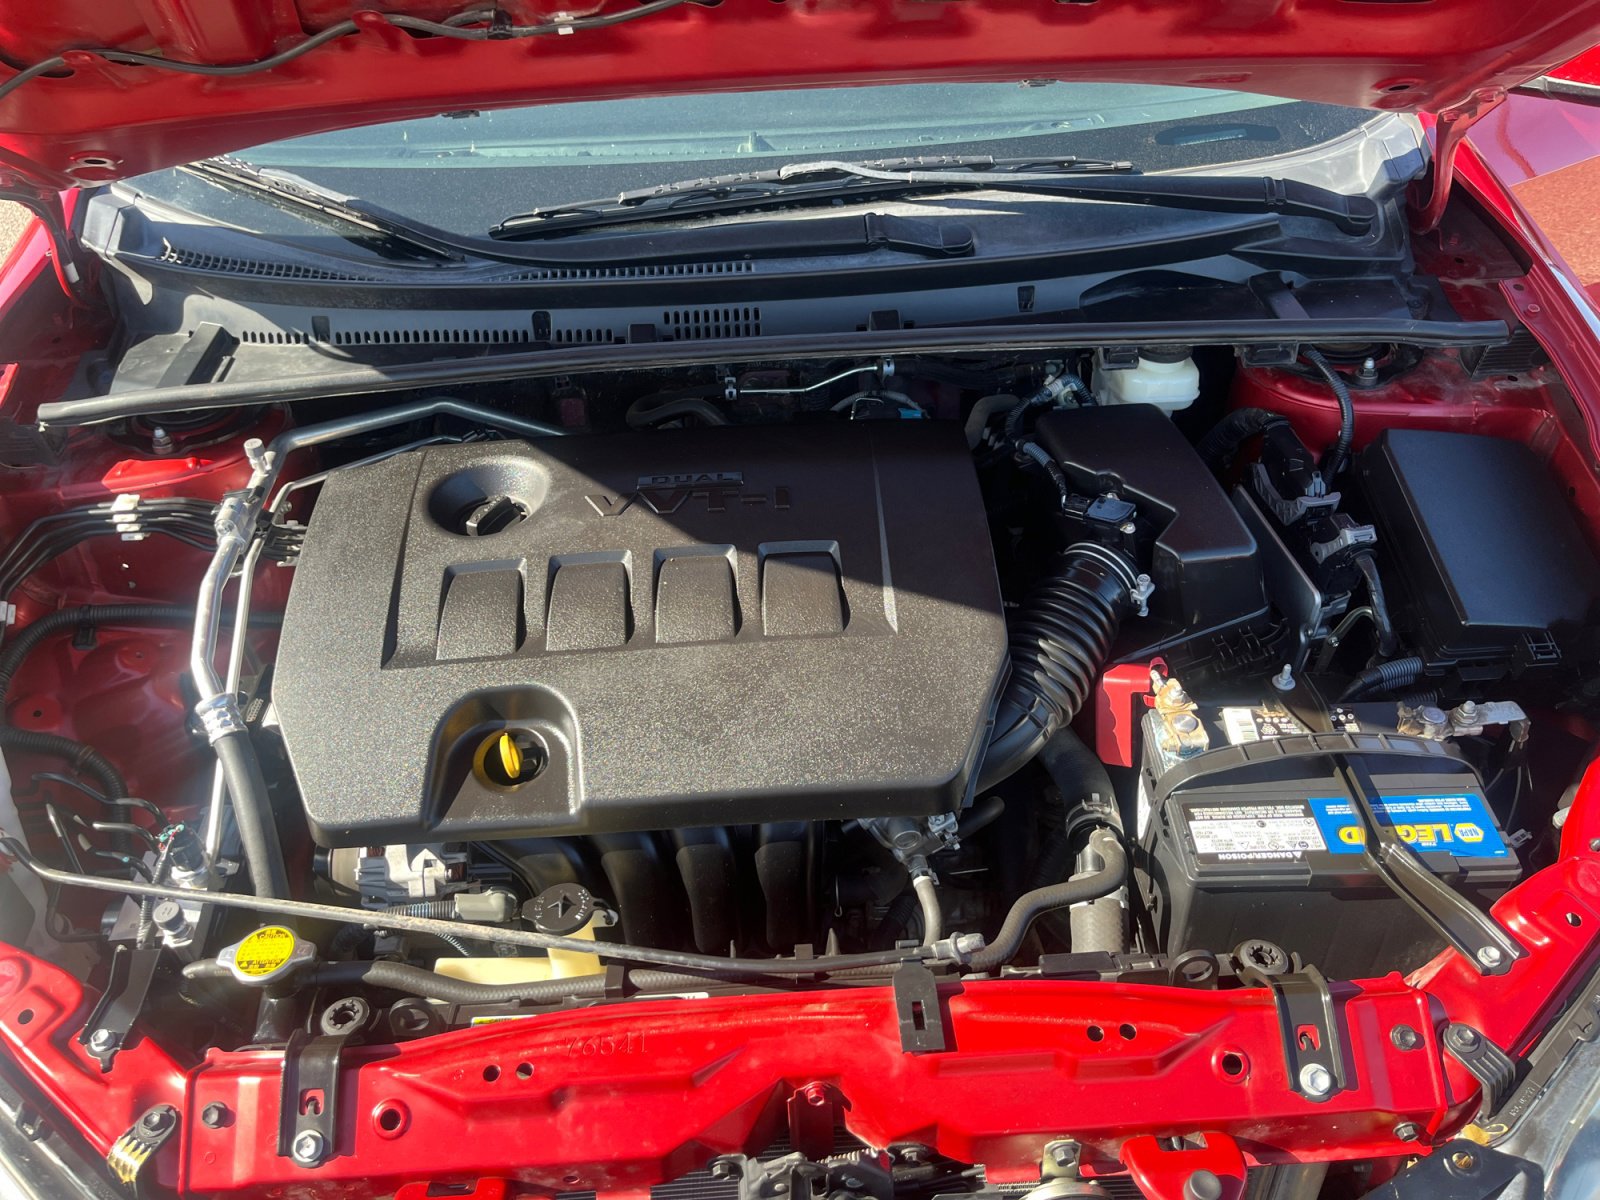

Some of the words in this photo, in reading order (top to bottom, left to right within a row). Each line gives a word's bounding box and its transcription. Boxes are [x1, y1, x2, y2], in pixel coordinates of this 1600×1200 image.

[651, 472, 733, 485] DUAL
[1457, 827, 1480, 838] NAPA
[1218, 851, 1294, 861] DANGER/POISON
